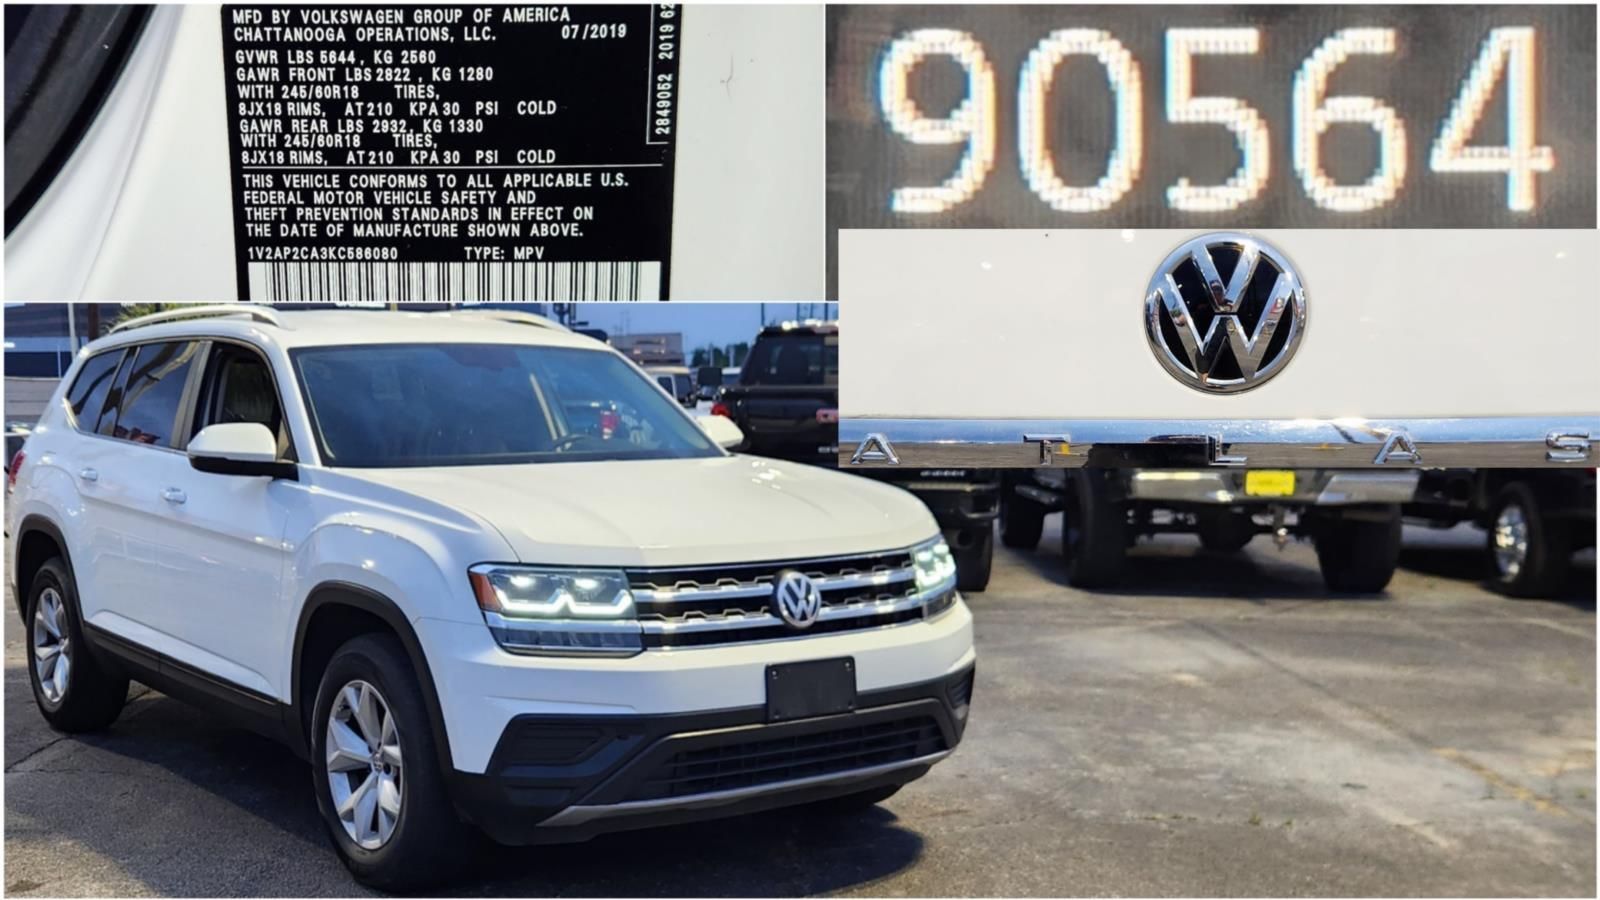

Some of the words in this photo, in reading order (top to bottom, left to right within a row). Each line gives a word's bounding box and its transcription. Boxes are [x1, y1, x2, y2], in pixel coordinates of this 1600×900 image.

[232, 9, 263, 24] MFD
[272, 9, 291, 24] BY
[301, 9, 404, 24] VOLKSWAGEN
[414, 9, 463, 24] GROUP
[473, 8, 493, 23] OF
[502, 7, 571, 22] AMERICA
[234, 27, 346, 41] CHATTANOOGA
[356, 27, 455, 43] OPERATIONS,
[464, 26, 497, 41] LLC.
[561, 24, 627, 39] 07/2019
[658, 24, 675, 60] 2019
[235, 50, 279, 64] GVWR
[287, 50, 314, 64] LBS
[374, 50, 393, 64] KG
[401, 50, 437, 64] 2560
[236, 67, 280, 81] GAWR
[289, 67, 336, 81] FRONT
[345, 67, 372, 81] LBS
[432, 67, 452, 81] KG
[459, 67, 494, 81] 1280
[237, 85, 274, 99] WITH
[281, 85, 359, 100] 245/60R18
[394, 85, 440, 101] TIRES,
[239, 102, 282, 116] 8JX18
[287, 102, 326, 117] RIMS,
[344, 102, 364, 116] AT
[367, 102, 393, 116] 210
[409, 102, 439, 116] KPA
[443, 102, 460, 116] 30
[475, 101, 499, 115] PSI
[517, 101, 557, 115] COLD
[656, 73, 673, 135] 2849052
[239, 119, 283, 133] GAWR
[291, 119, 329, 133] REAR
[338, 119, 364, 133] LBS
[423, 119, 442, 133] KG
[449, 119, 484, 133] 1330
[878, 26, 1555, 214] 90564
[240, 134, 277, 148] WITH
[284, 134, 361, 148] 245/60R18
[392, 134, 438, 149] TIRES,
[241, 151, 285, 165] 8JX18
[289, 151, 328, 166] RIMS,
[346, 151, 366, 165] AT
[368, 151, 394, 165] 210
[410, 151, 440, 165] KPA
[443, 151, 461, 165] 30
[475, 150, 499, 164] PSI
[516, 150, 556, 164] COLD
[242, 174, 274, 188] THIS
[282, 174, 340, 188] VEHICLE
[349, 174, 428, 188] CONFORMS
[436, 174, 457, 188] TO
[466, 174, 494, 188] ALL
[503, 173, 592, 188] APPLICABLE
[600, 172, 629, 186] U.S.
[243, 191, 305, 205] FEDERAL
[313, 191, 365, 205] MOTOR
[373, 191, 432, 205] VEHICLE
[441, 191, 497, 205] SAFETY
[506, 190, 536, 204] AND
[244, 207, 287, 221] THEFT
[296, 207, 383, 221] PREVENTION
[392, 207, 479, 221] STANDARDS
[488, 207, 502, 221] IN
[510, 207, 564, 220] EFFECT
[573, 206, 594, 220] ON
[245, 223, 272, 237] THE
[280, 223, 317, 237] DATE
[326, 223, 344, 237] OF
[353, 223, 458, 237] MANUFACTURE
[467, 223, 521, 237] SHOWN
[529, 223, 584, 237] ABOVE.
[248, 247, 398, 260] 1V2AP2CA3KC586080
[464, 247, 505, 260] TYPE:
[513, 247, 545, 260] MPV
[850, 432, 1593, 467] ATLAS
